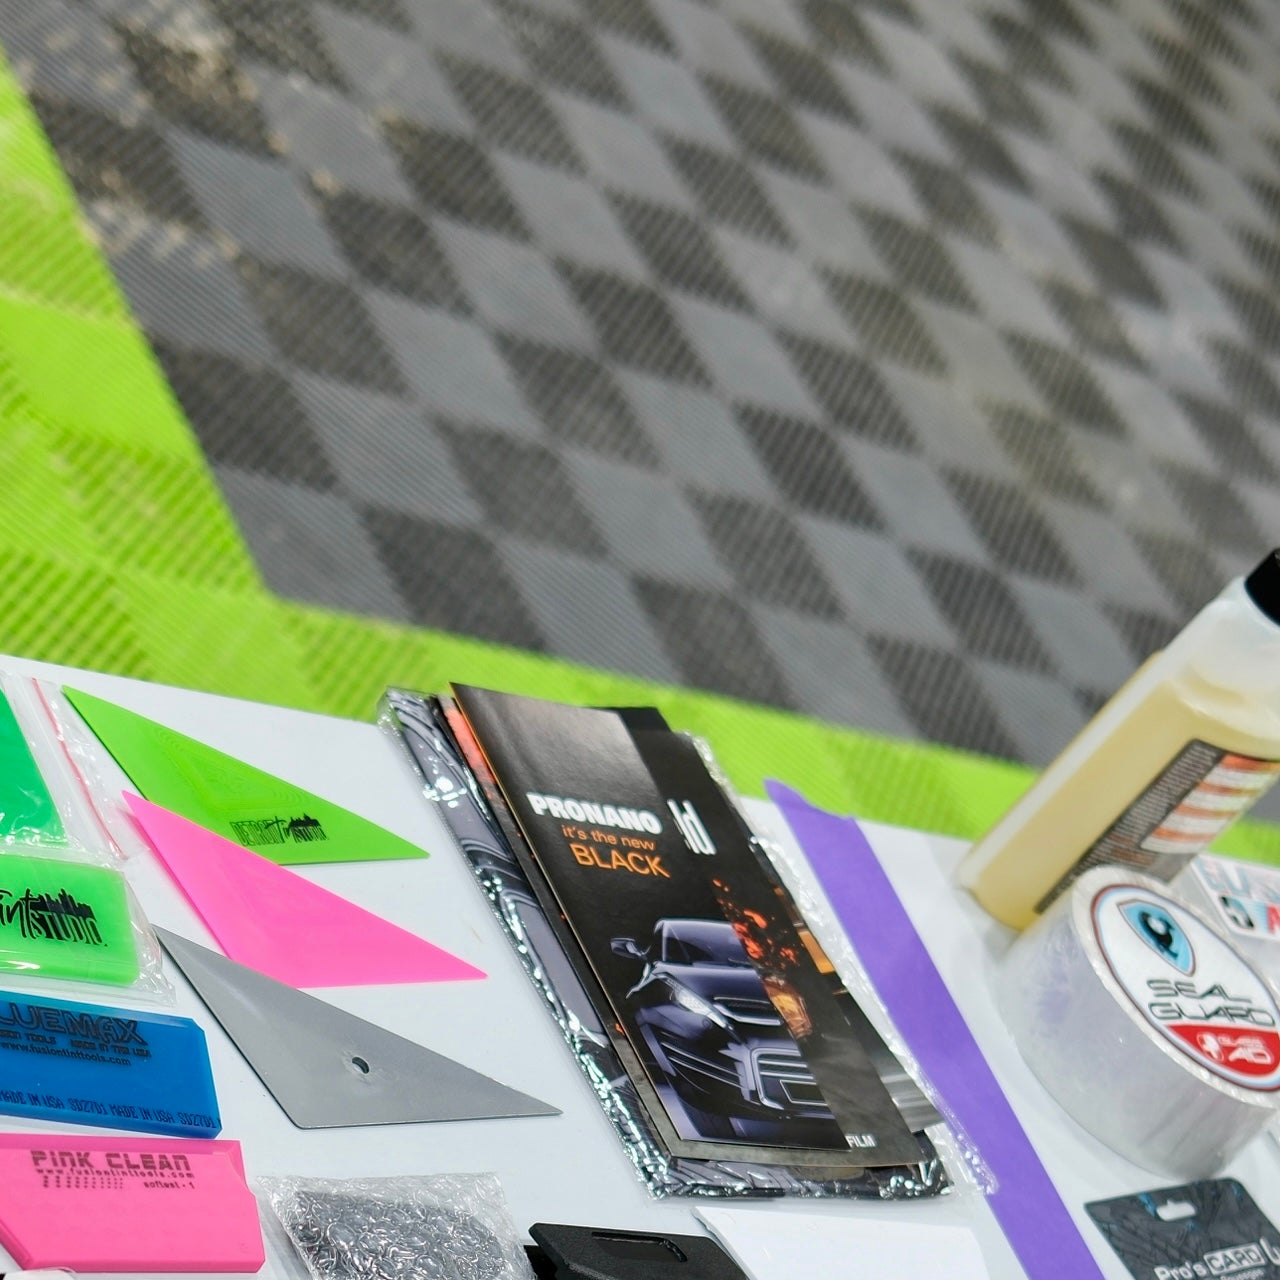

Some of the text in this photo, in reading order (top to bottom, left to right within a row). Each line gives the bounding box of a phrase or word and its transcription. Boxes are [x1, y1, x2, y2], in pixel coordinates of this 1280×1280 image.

[526, 792, 664, 835] PRONANO
[562, 825, 656, 851] it's the new
[570, 843, 671, 879] BLACK
[1146, 979, 1253, 1003] SEAL
[1148, 1002, 1276, 1026] GUARD
[25, 1033, 57, 1045] TOOLS
[0, 1041, 132, 1067] www.fusiontinttools.com
[1227, 1046, 1274, 1065] AID
[27, 1092, 40, 1105] IN
[42, 1095, 66, 1109] USA
[110, 1103, 139, 1119] MADE
[140, 1107, 153, 1120] IN
[153, 1109, 175, 1123] USA
[845, 1134, 876, 1148] FILM
[30, 1149, 192, 1172] PINK CLEAN
[35, 1168, 196, 1179] www.fusiontinttools.com
[1204, 1244, 1265, 1275] CARD
